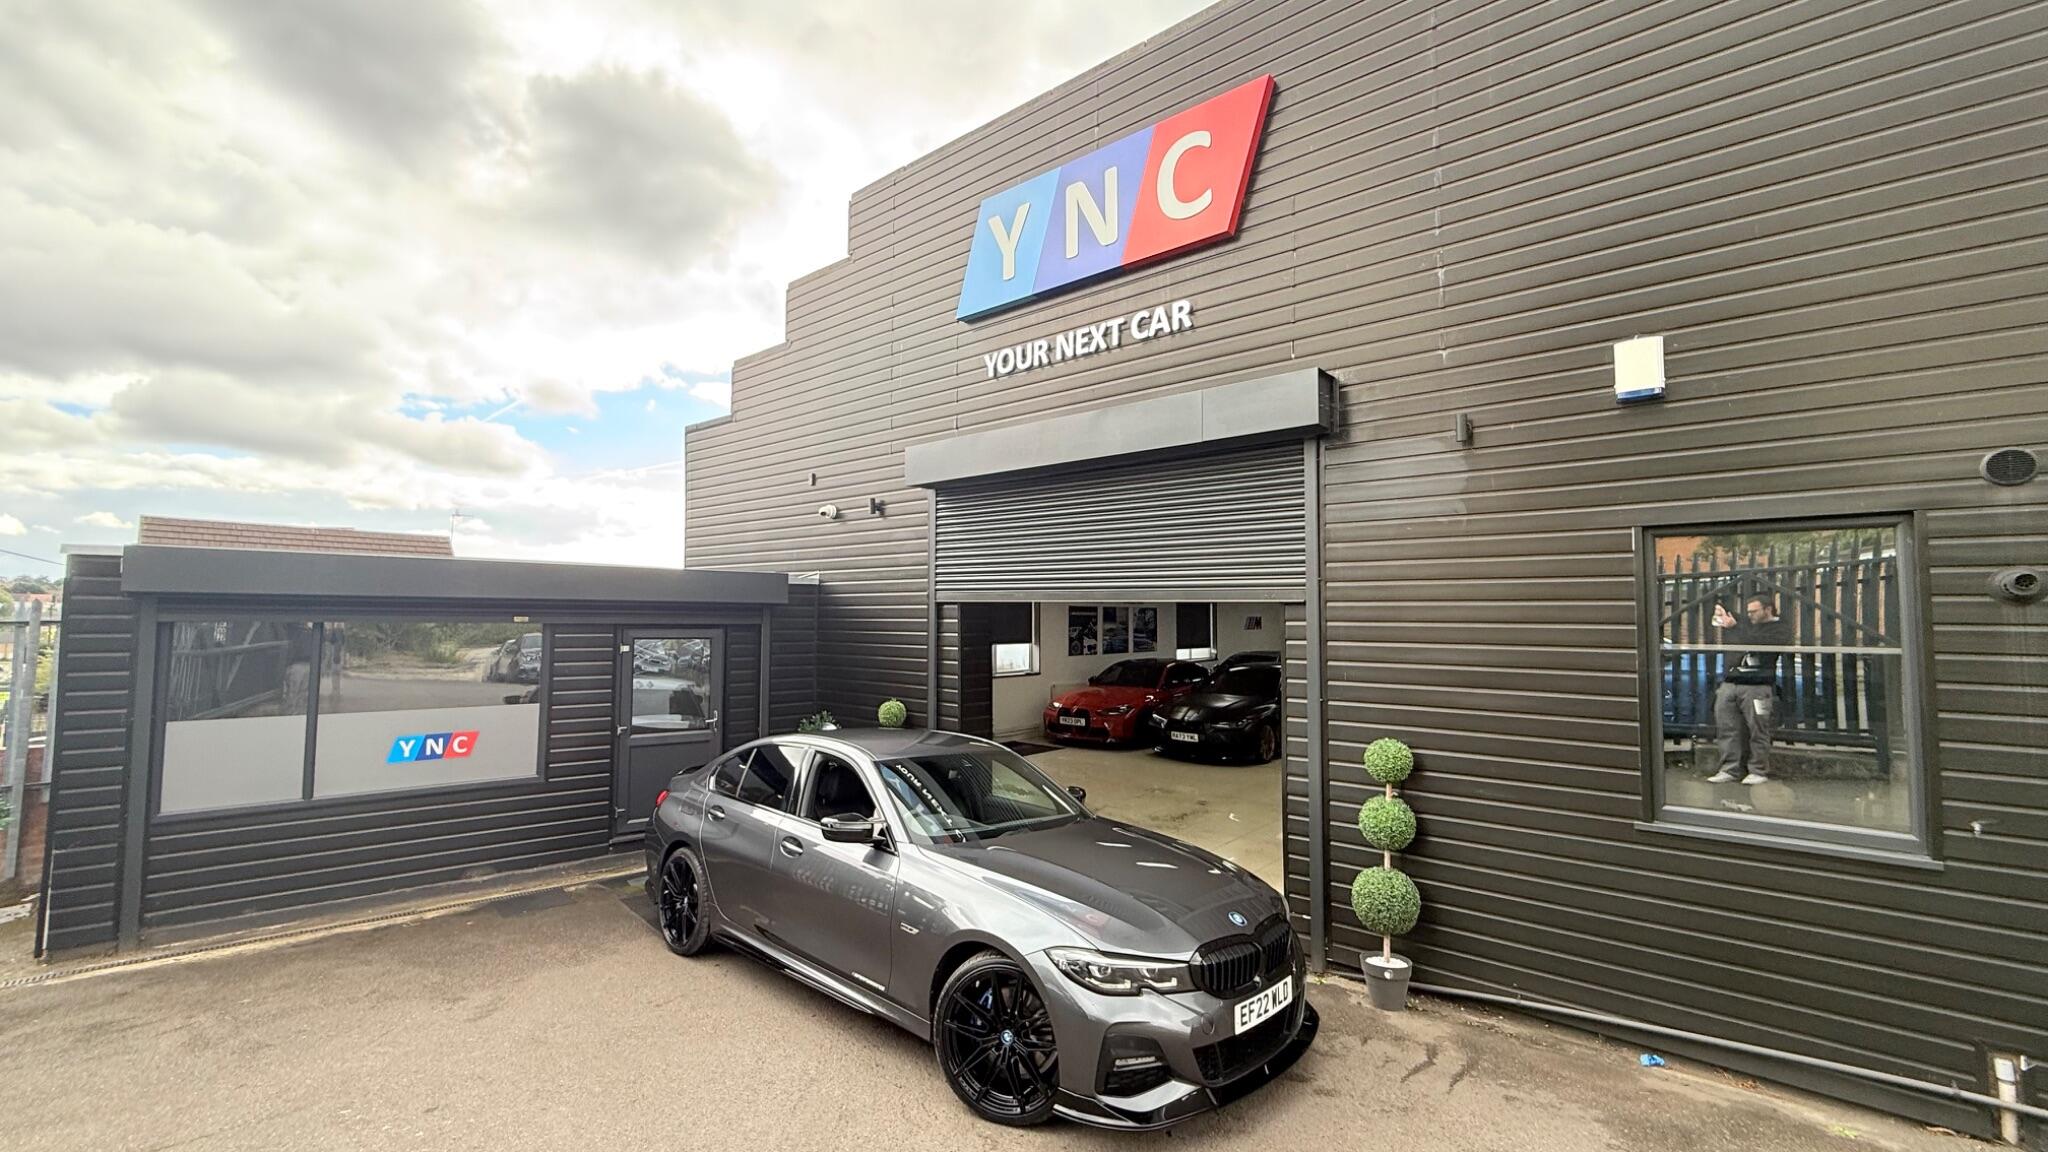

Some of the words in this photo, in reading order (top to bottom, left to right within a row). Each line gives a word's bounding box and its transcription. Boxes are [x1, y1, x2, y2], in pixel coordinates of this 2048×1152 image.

[988, 130, 1213, 281] YNC
[984, 339, 1049, 378] YOUR
[1055, 317, 1126, 361] NEXT
[1130, 299, 1193, 340] CAR
[398, 735, 469, 758] YNC
[1240, 993, 1270, 1027] EF22
